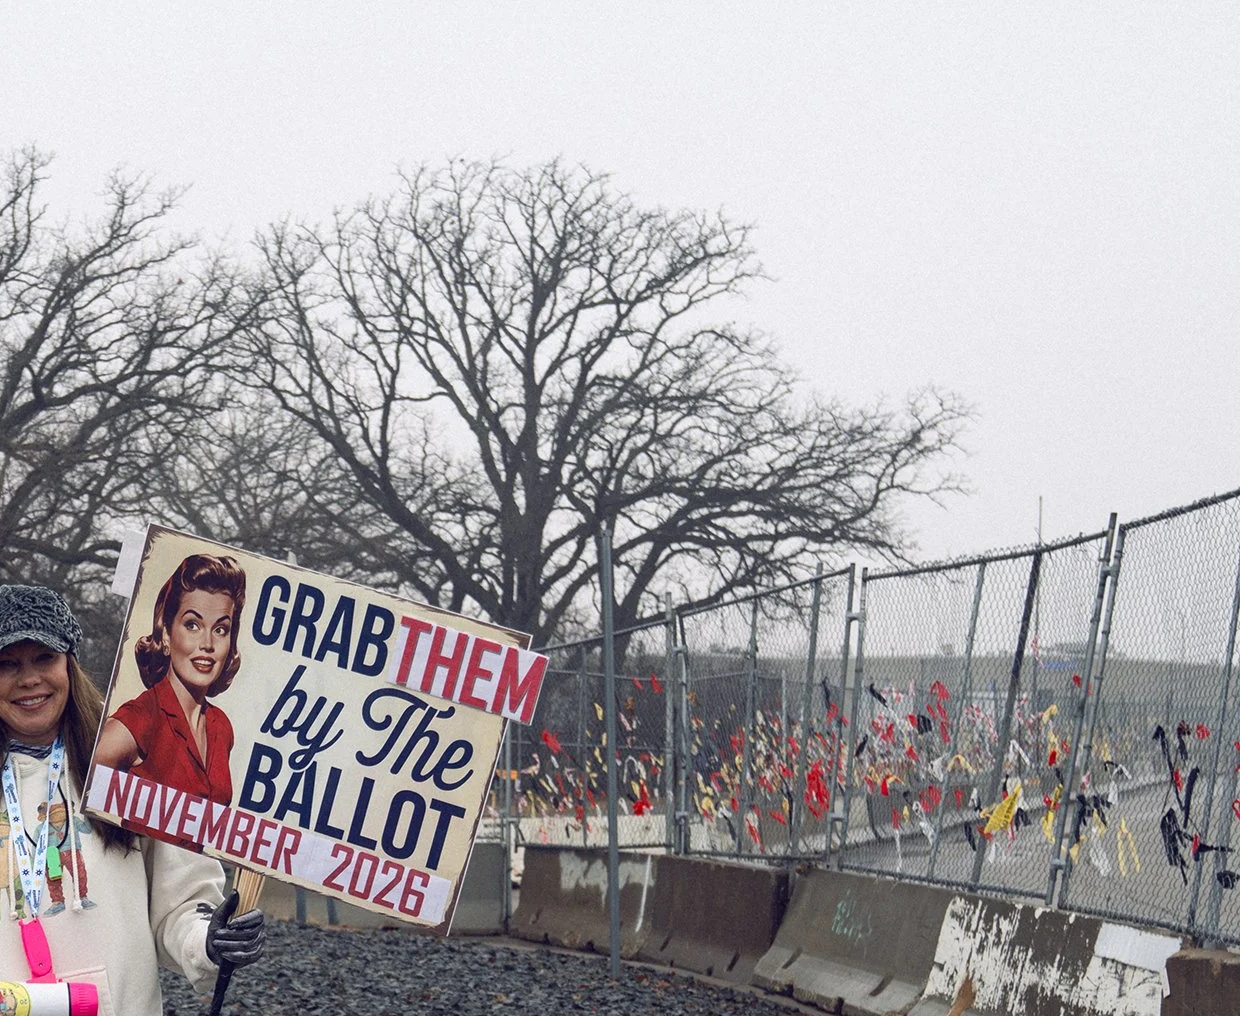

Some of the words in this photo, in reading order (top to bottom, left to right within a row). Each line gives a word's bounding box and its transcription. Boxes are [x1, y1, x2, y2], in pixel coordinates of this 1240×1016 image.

[251, 574, 395, 677] GRAB
[395, 615, 549, 723] THEM
[260, 664, 345, 771] by
[355, 687, 474, 791] The
[102, 770, 303, 876] NOVEMBER
[322, 843, 431, 919] 2026
[238, 741, 466, 871] BALLOT
